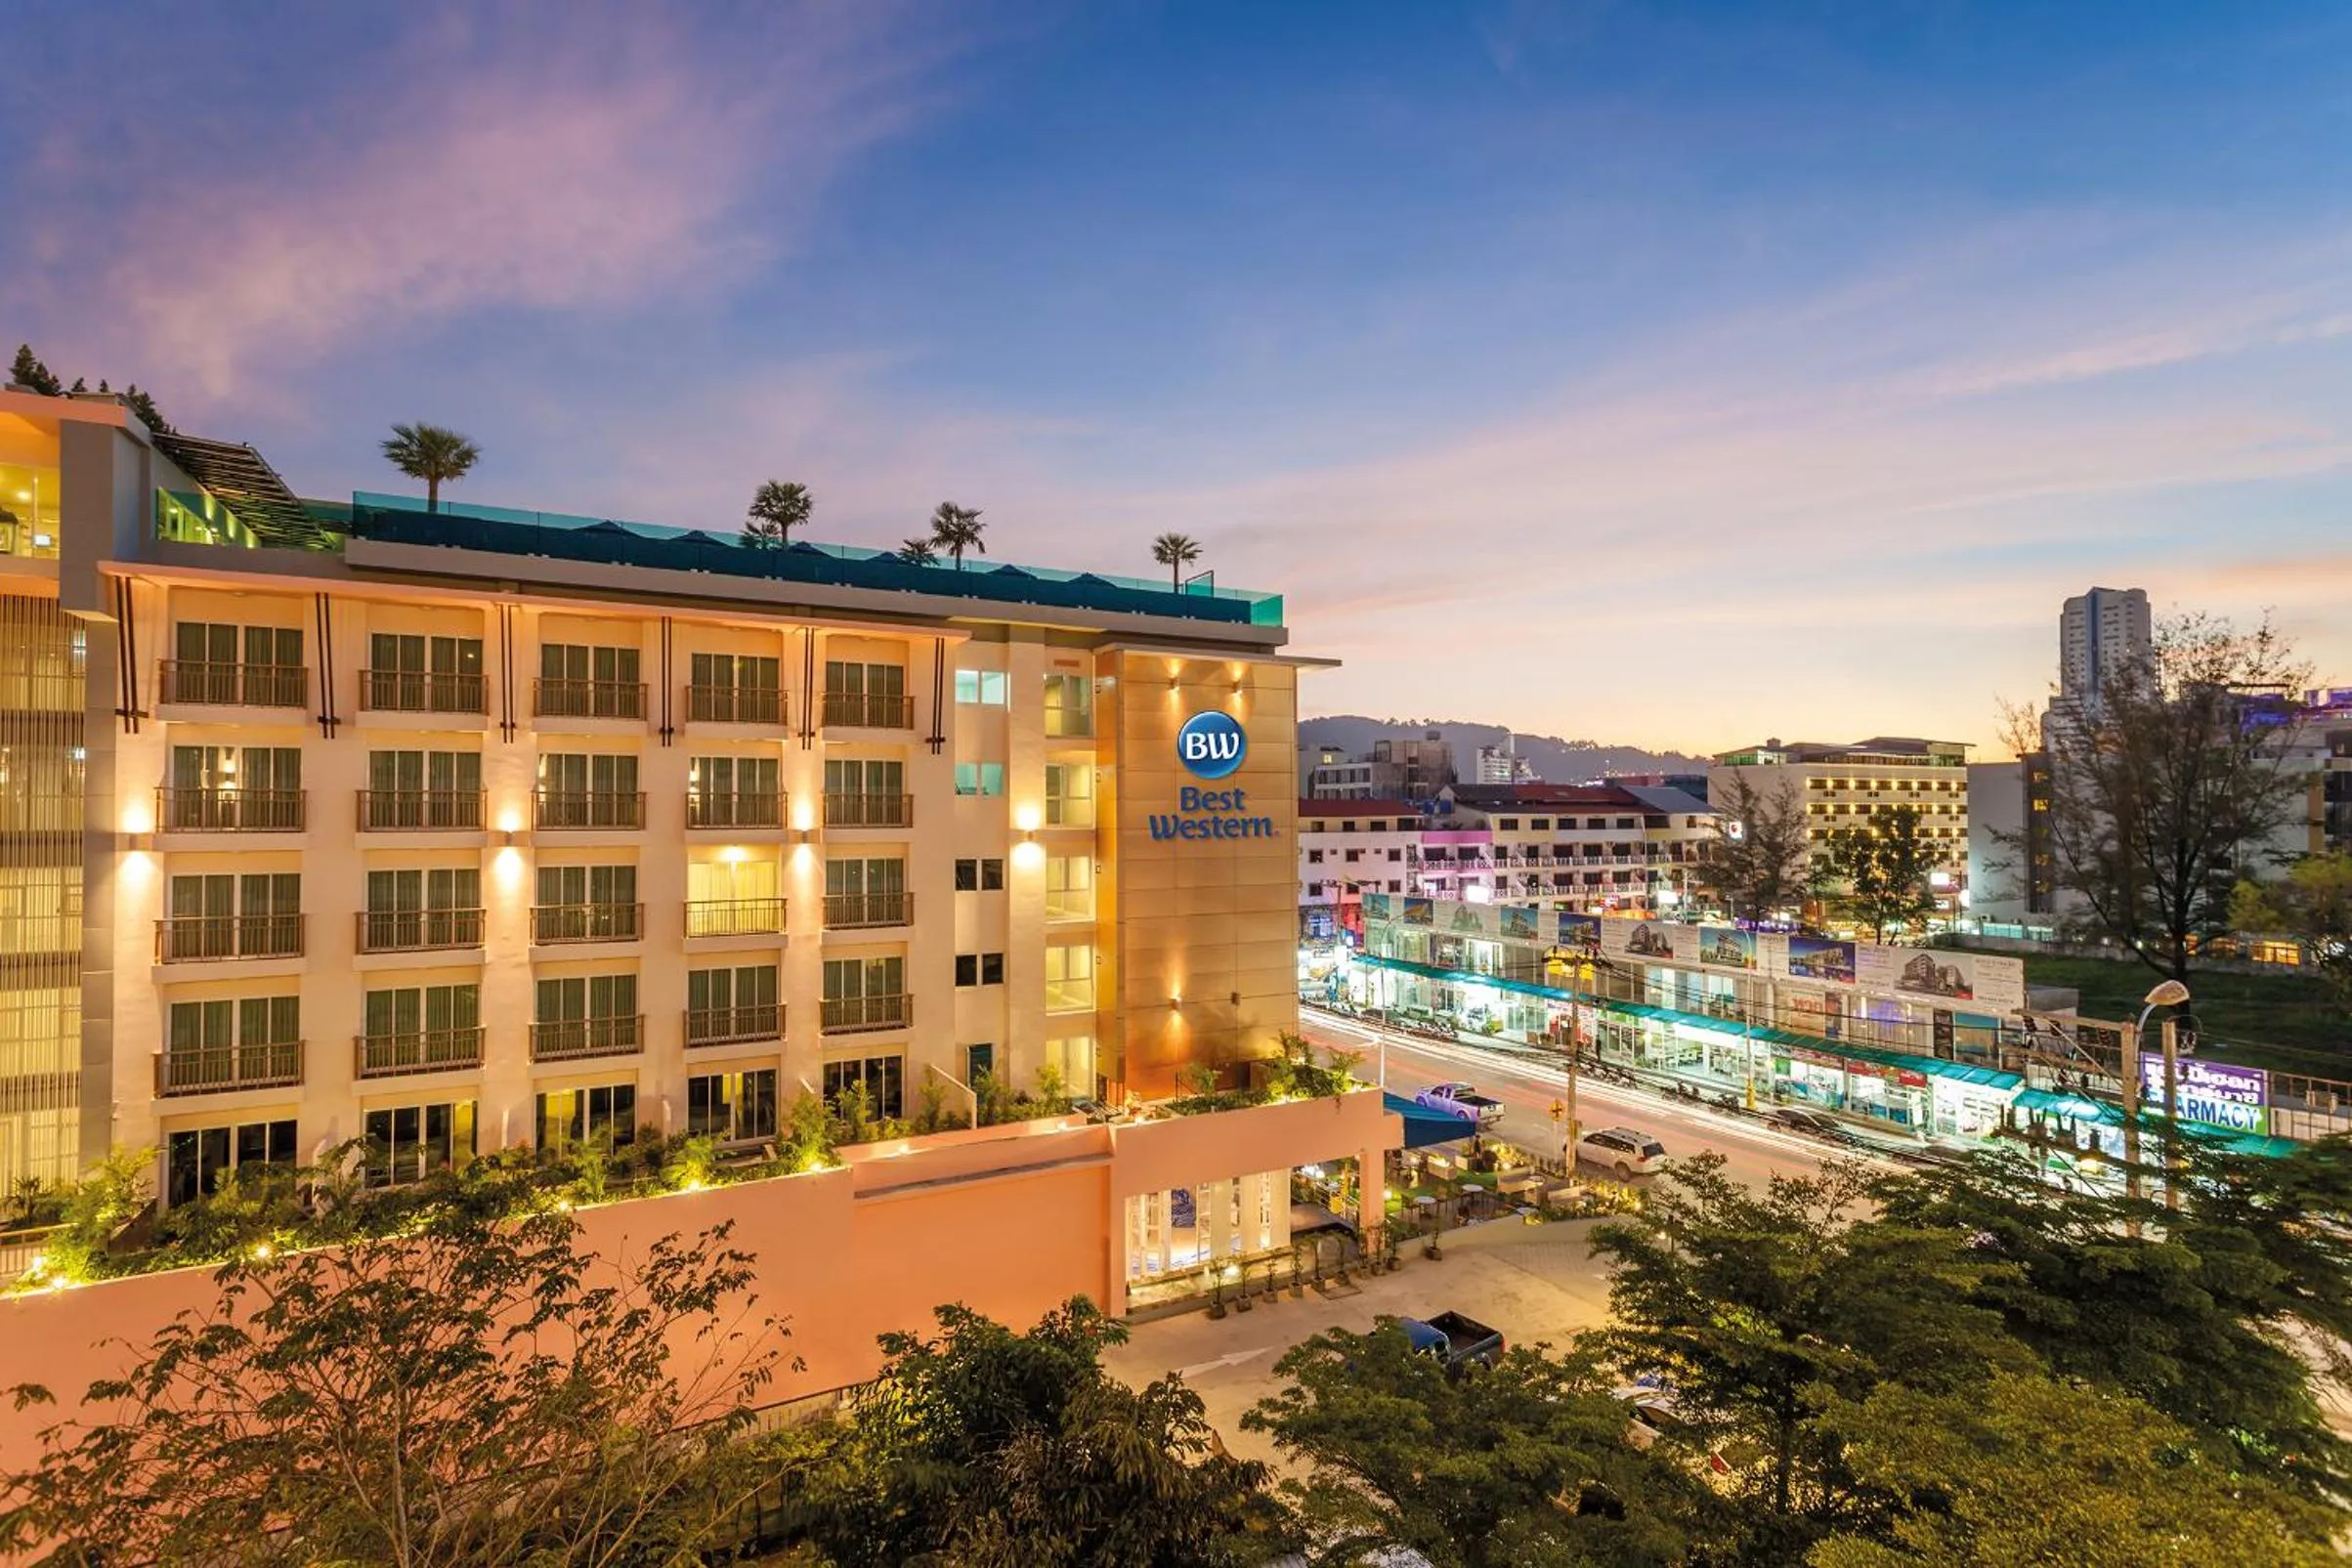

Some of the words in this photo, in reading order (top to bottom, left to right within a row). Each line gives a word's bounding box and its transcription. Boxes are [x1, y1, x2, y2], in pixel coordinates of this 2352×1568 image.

[1185, 732, 1240, 760] BW
[1179, 785, 1246, 812] Best
[1148, 814, 1274, 841] Western
[2174, 1096, 2257, 1129] ARMACY
